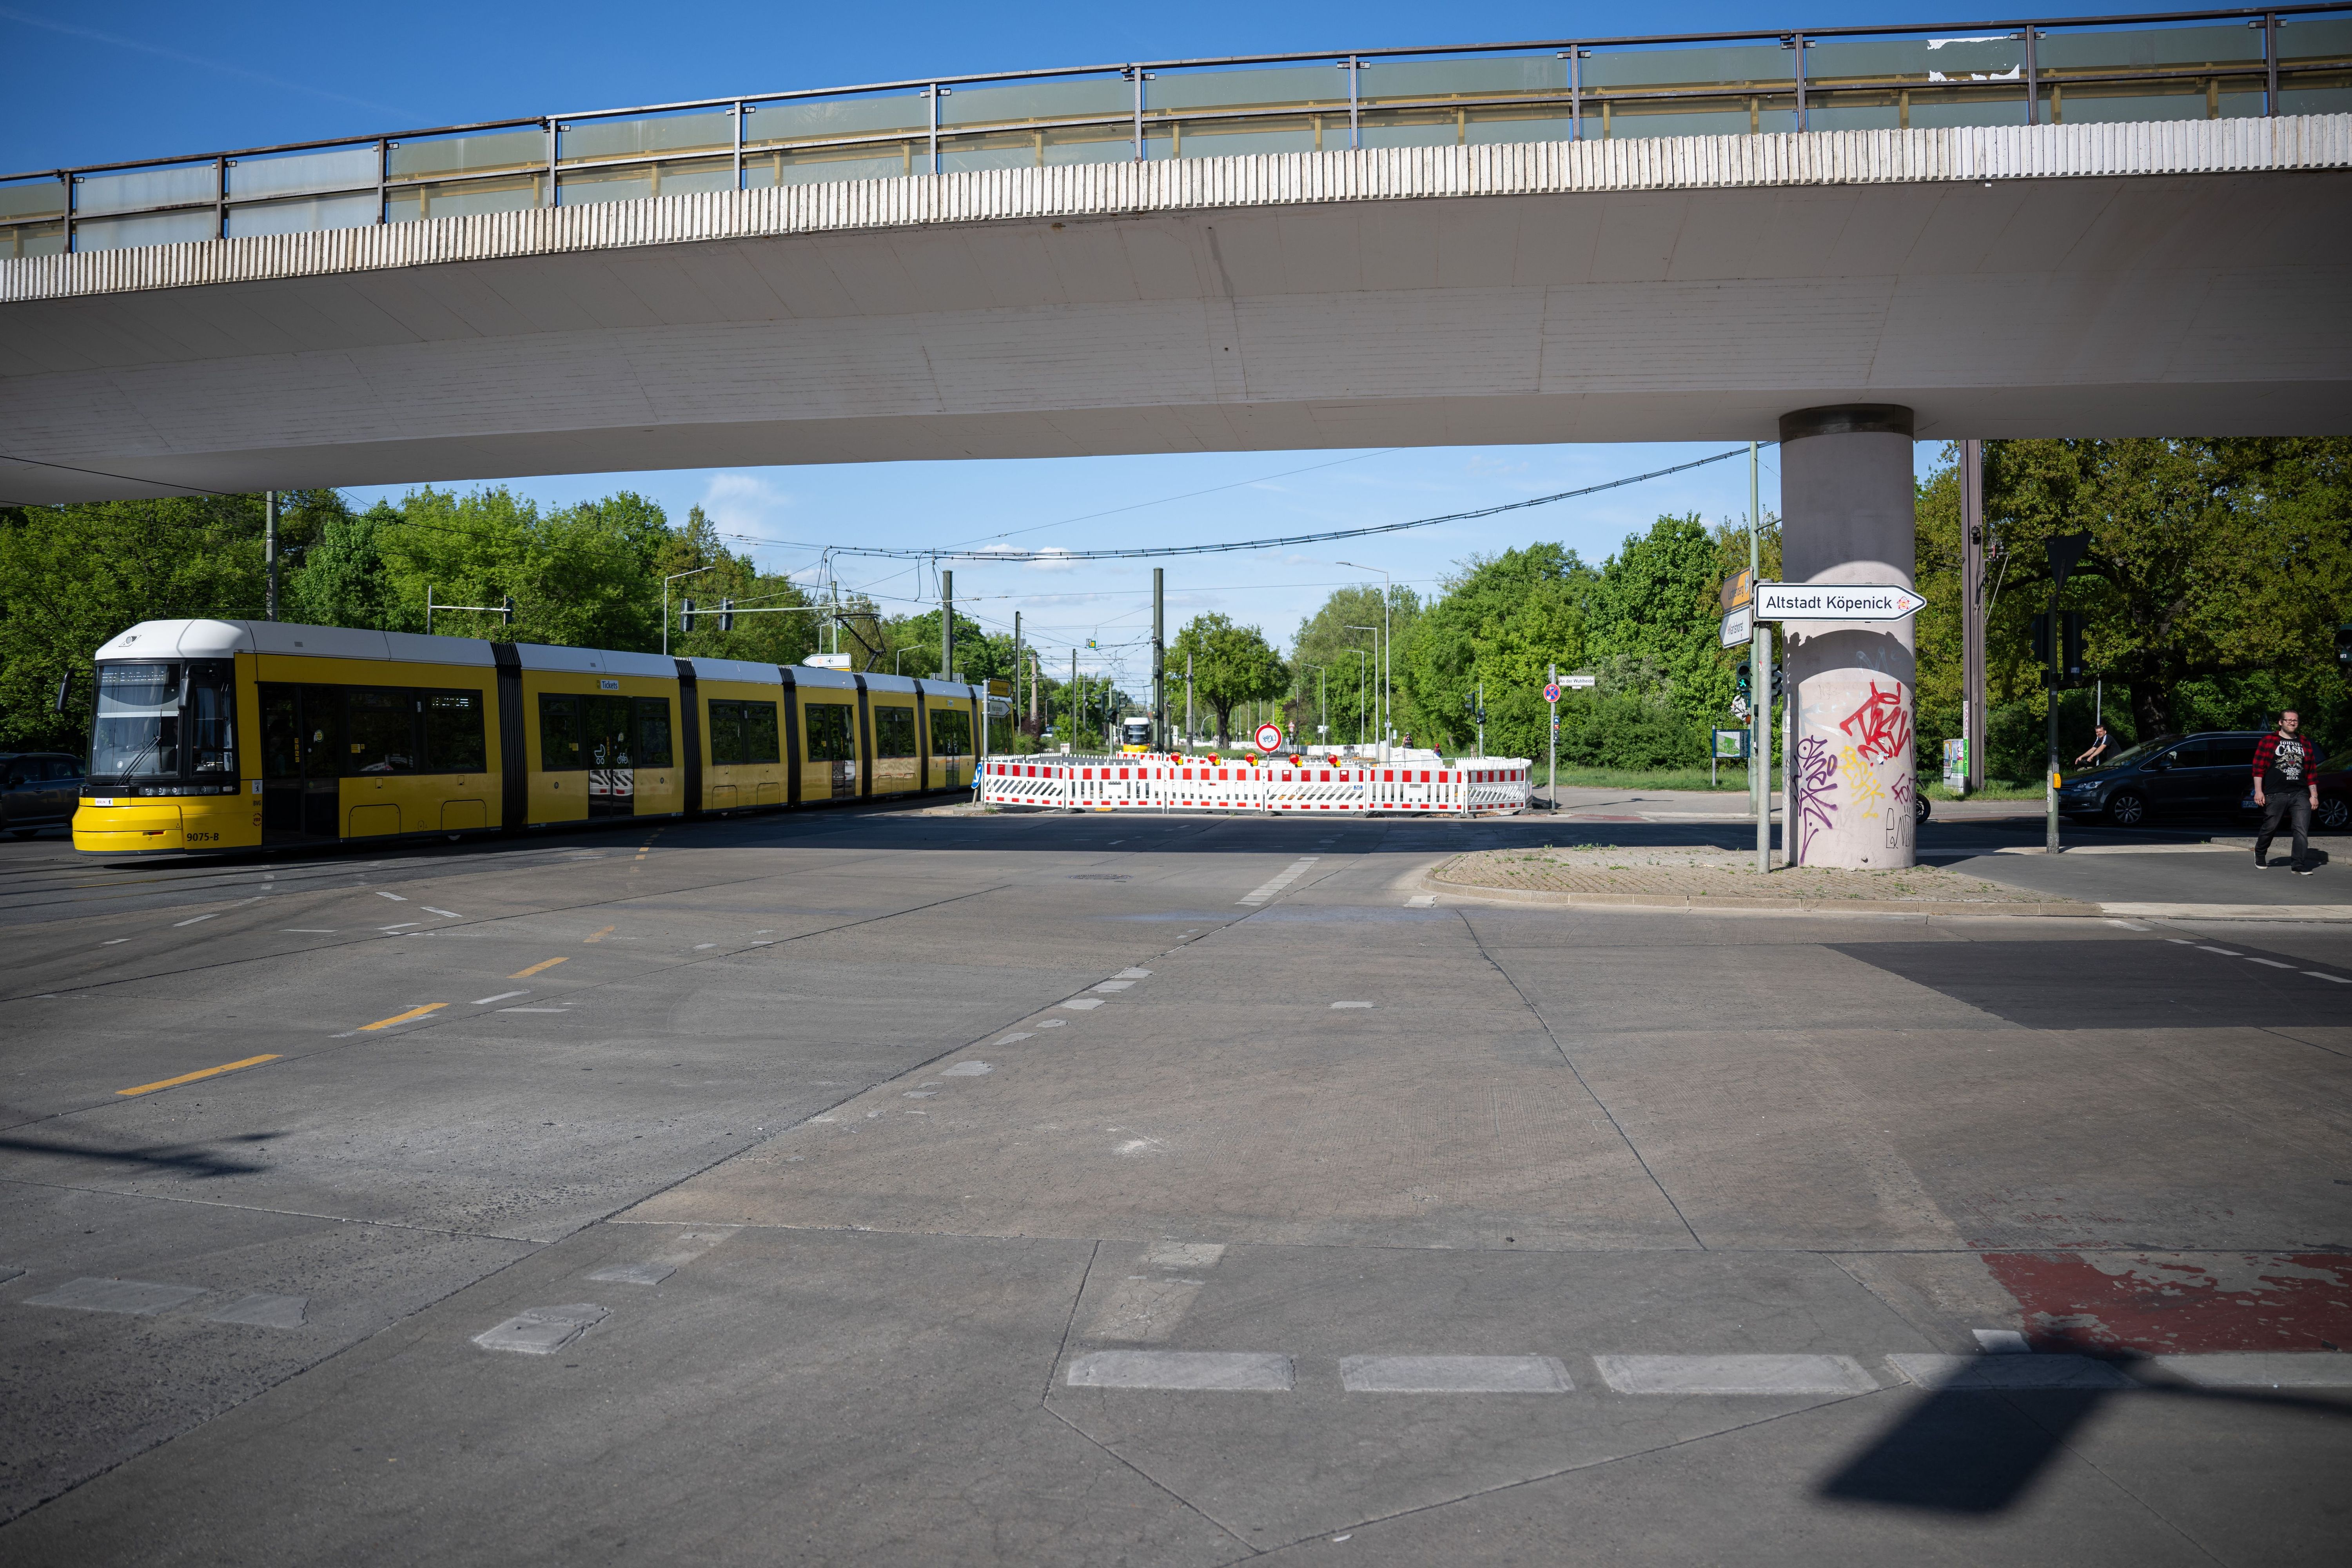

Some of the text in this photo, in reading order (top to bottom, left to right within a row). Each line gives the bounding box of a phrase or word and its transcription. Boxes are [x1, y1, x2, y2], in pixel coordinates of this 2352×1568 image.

[1766, 596, 1821, 608] Altstadt
[1827, 596, 1892, 612] Köpenick
[602, 681, 618, 689] Tickets
[2275, 745, 2305, 757] CASH
[187, 833, 219, 841] 9075-B
